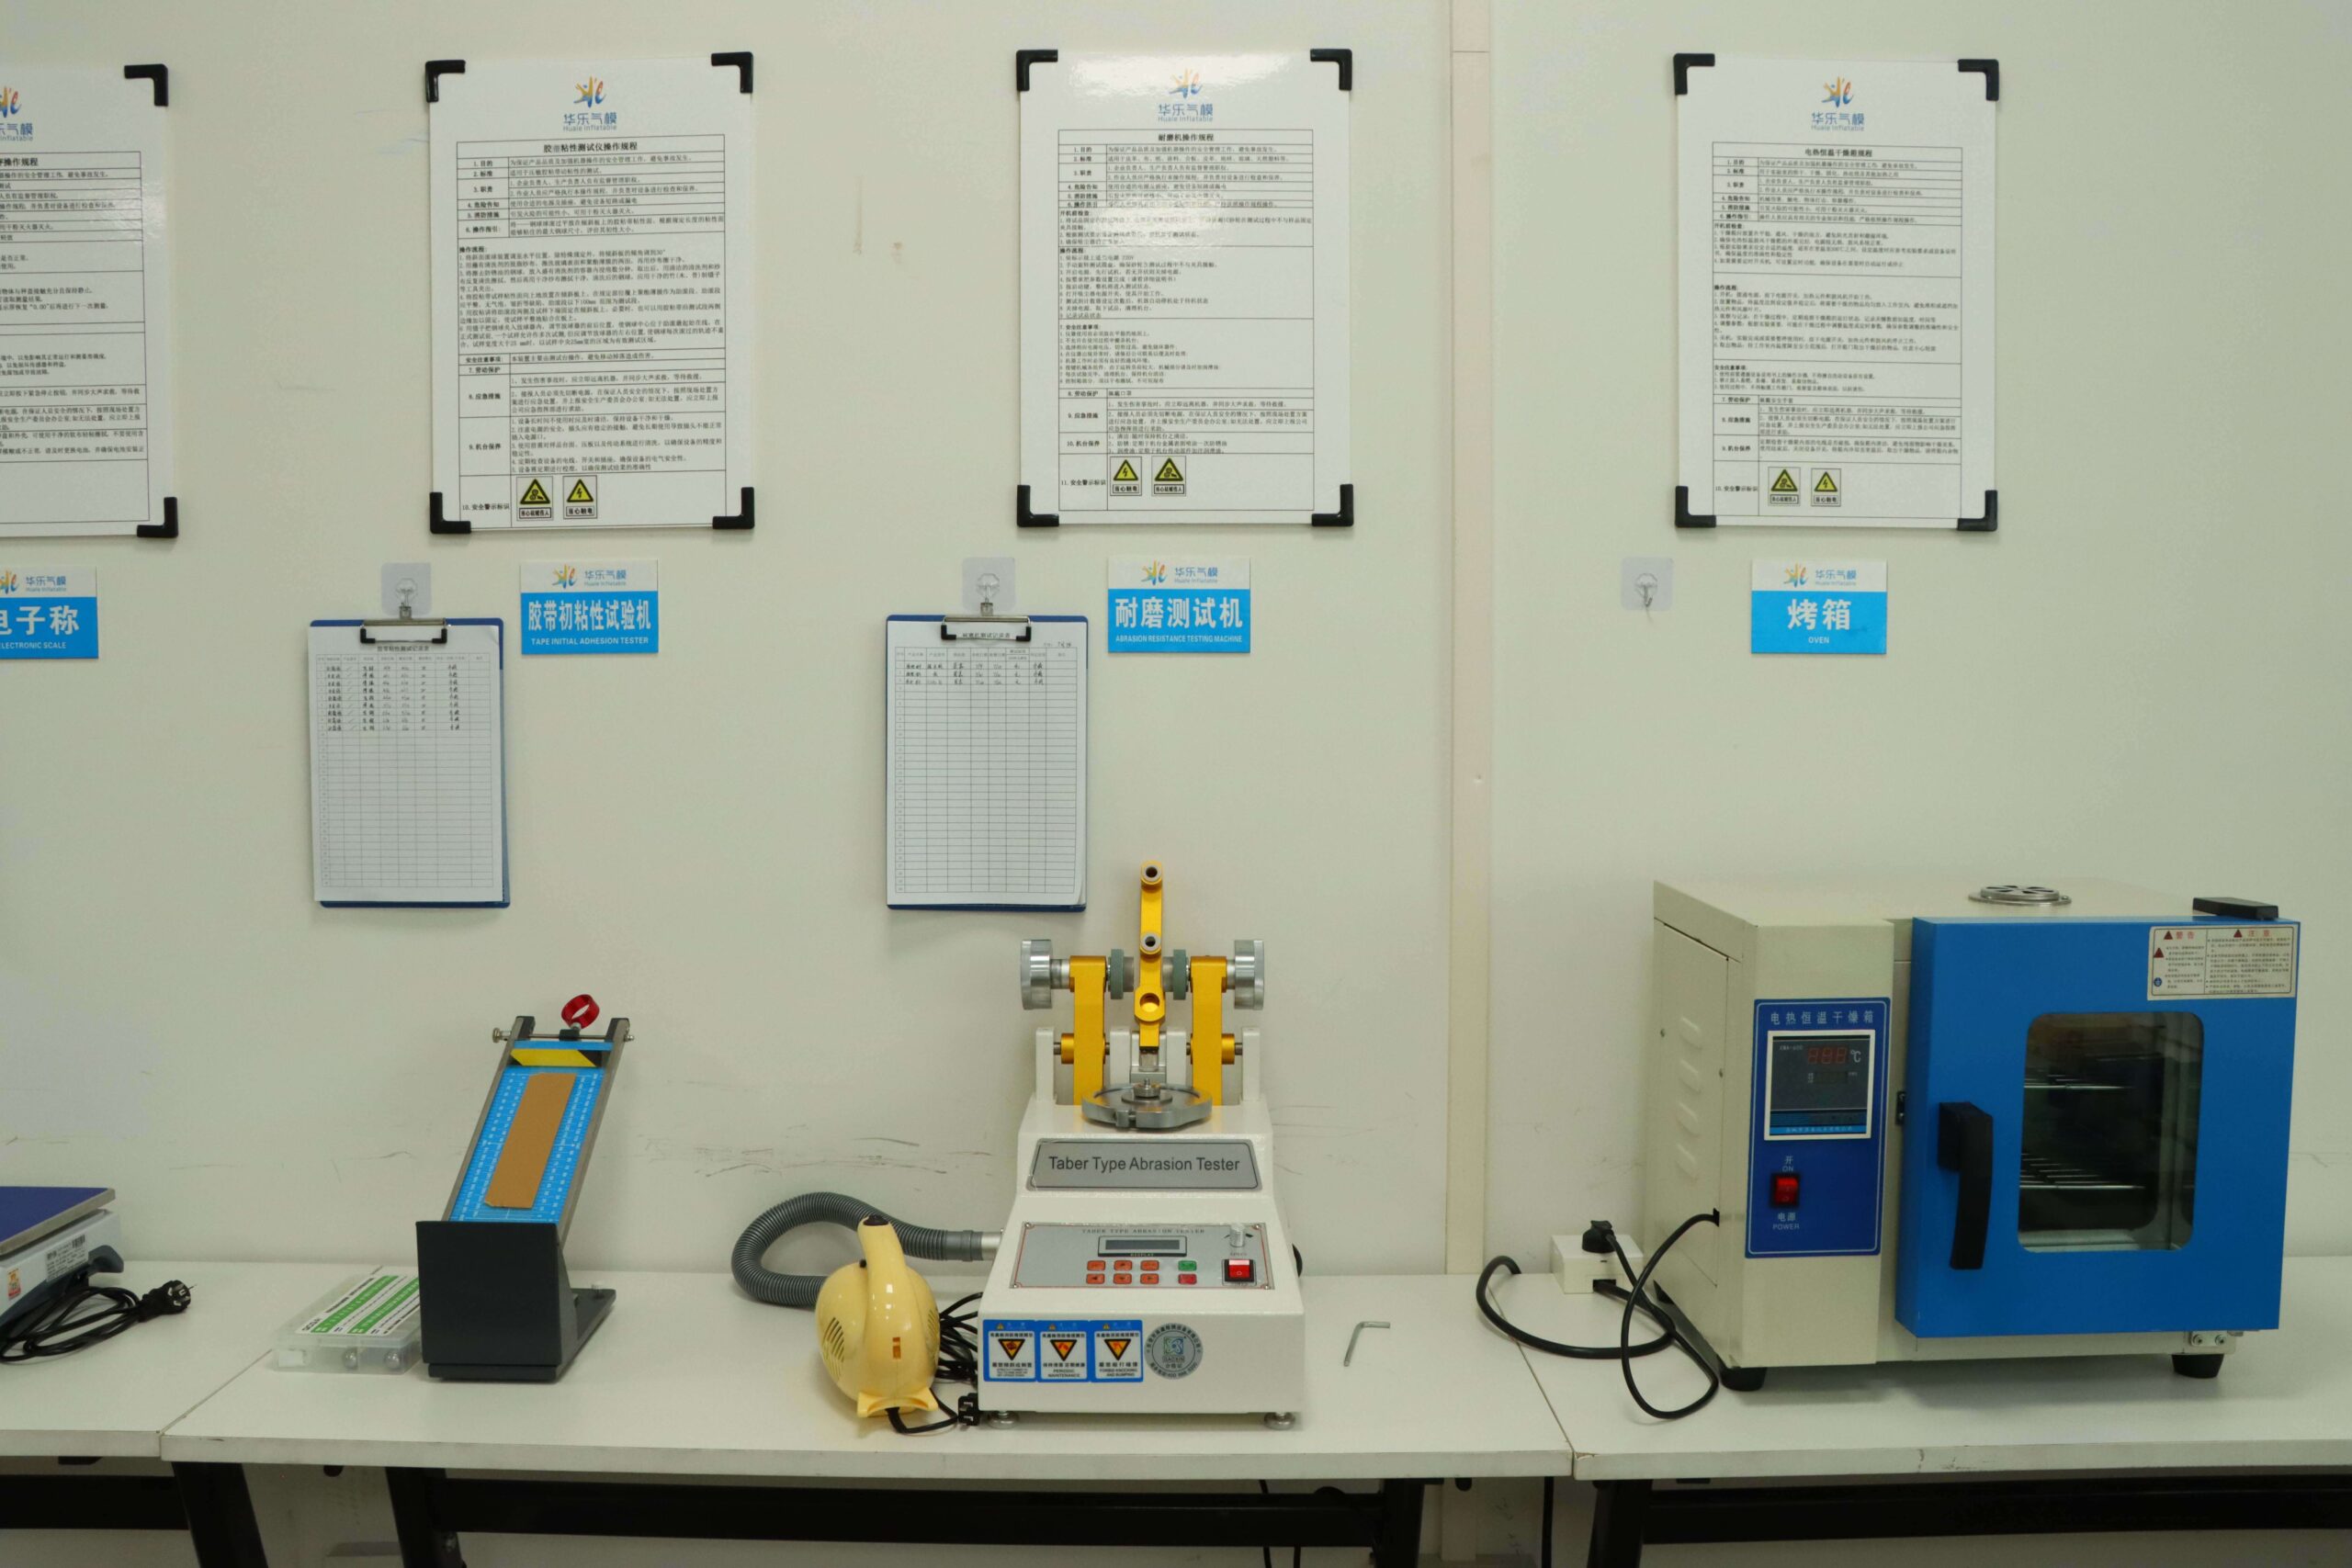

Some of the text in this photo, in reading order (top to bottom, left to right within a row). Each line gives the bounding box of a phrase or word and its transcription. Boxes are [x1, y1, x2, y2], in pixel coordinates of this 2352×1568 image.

[528, 600, 650, 631] 胶带初粘性试验机
[1115, 596, 1242, 628] 耐磨测试机
[1787, 599, 1851, 630] 烤箱
[1770, 1010, 1873, 1025] 电热恒温干燥箱
[1049, 1156, 1240, 1173] Taber Type Abrasion Tester
